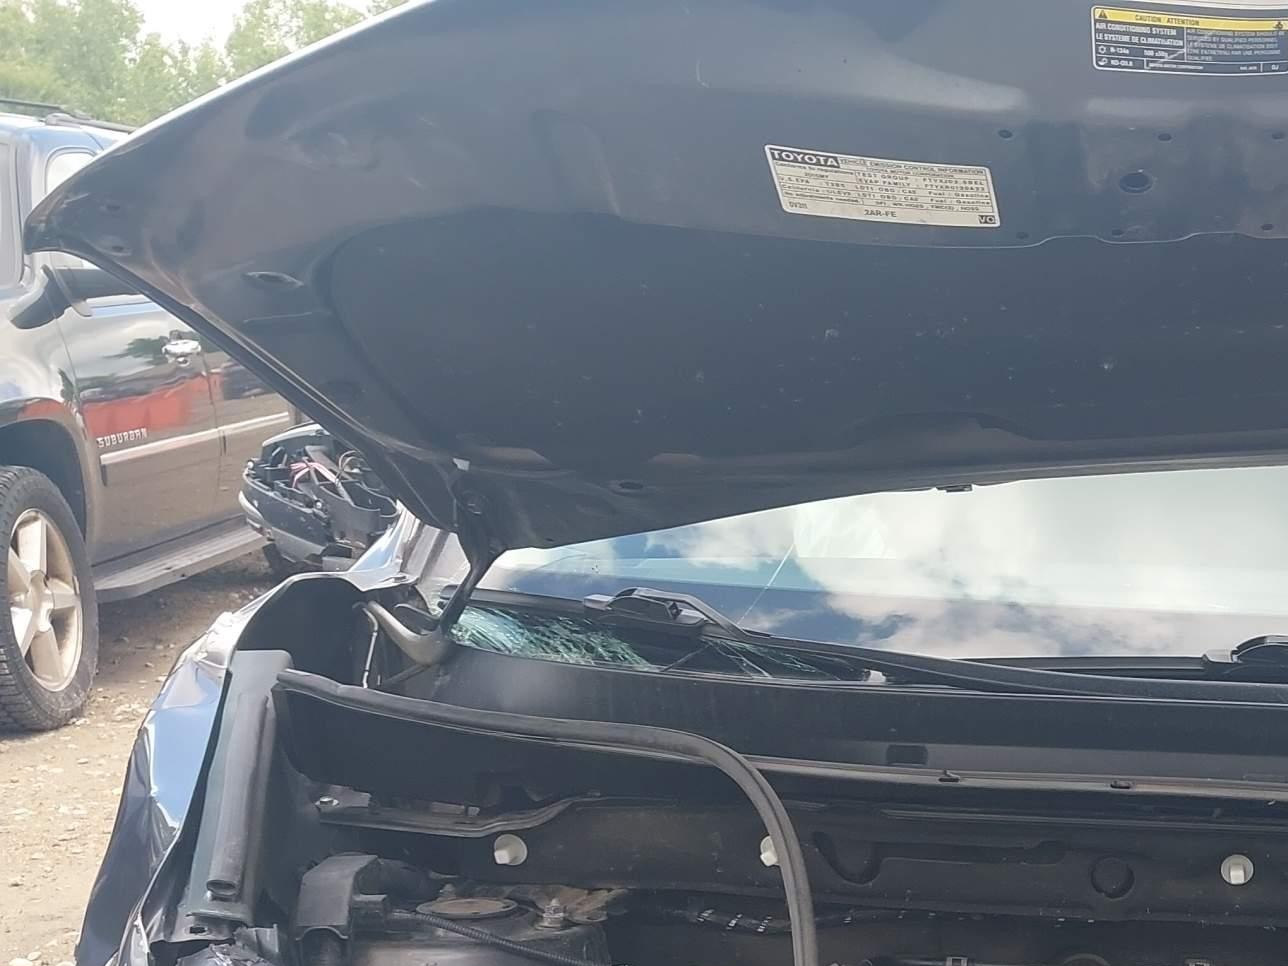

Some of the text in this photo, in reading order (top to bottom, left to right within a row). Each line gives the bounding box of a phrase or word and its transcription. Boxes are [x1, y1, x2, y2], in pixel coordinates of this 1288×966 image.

[1152, 27, 1177, 36] SYSTEM
[770, 150, 839, 167] TOYOTA
[96, 428, 147, 448] SUBURBAN
